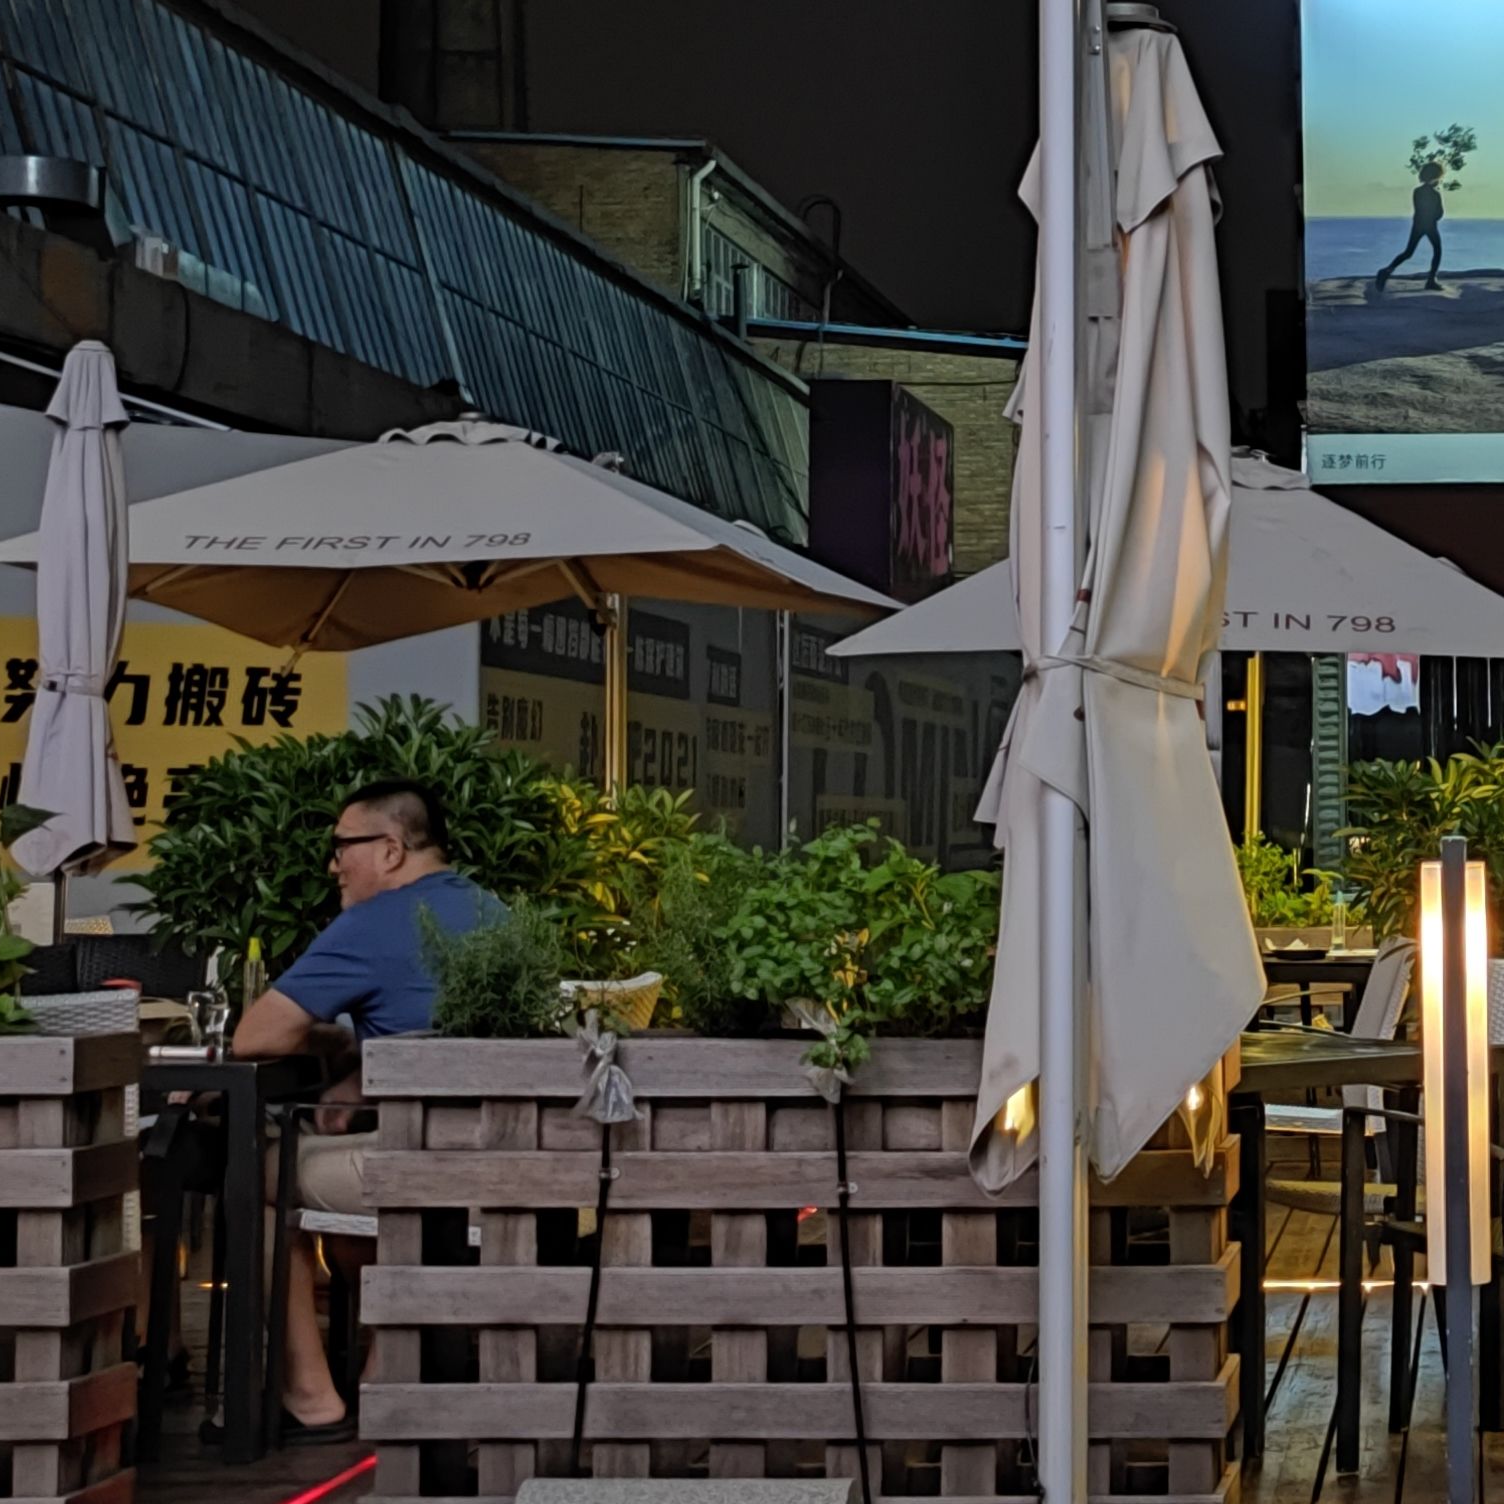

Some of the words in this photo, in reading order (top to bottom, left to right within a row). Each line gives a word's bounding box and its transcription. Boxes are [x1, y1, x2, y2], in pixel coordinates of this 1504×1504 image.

[1320, 452, 1388, 471] 逐梦前行
[184, 535, 267, 551] THE
[274, 535, 401, 551] FIRST
[407, 535, 452, 550] IN
[462, 532, 533, 548] 798
[1273, 612, 1311, 631] IN
[1326, 614, 1397, 634] 798
